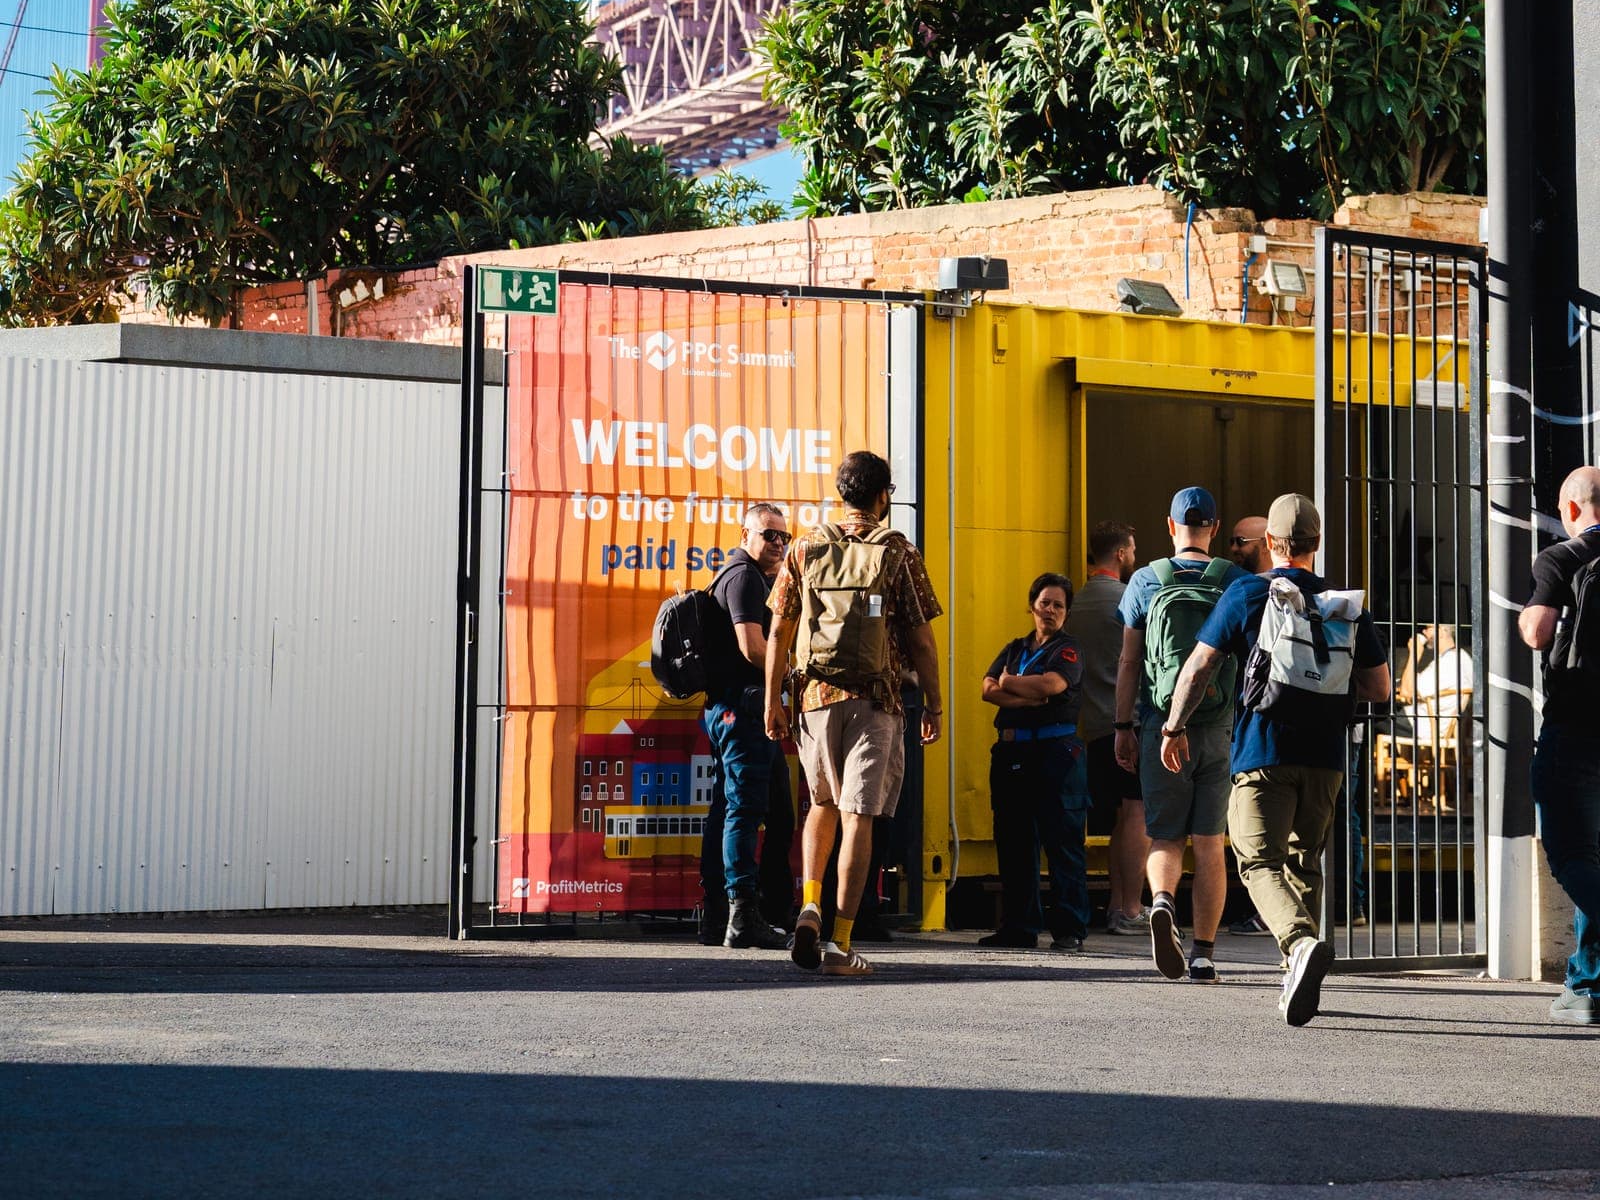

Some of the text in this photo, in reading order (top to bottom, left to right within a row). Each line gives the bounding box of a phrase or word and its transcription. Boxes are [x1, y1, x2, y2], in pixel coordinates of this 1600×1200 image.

[608, 337, 797, 368] The PPC Summit
[571, 418, 832, 474] WELCOME
[571, 490, 834, 528] to the futue of
[601, 538, 676, 575] paid
[536, 879, 623, 894] ProfitMetrics
